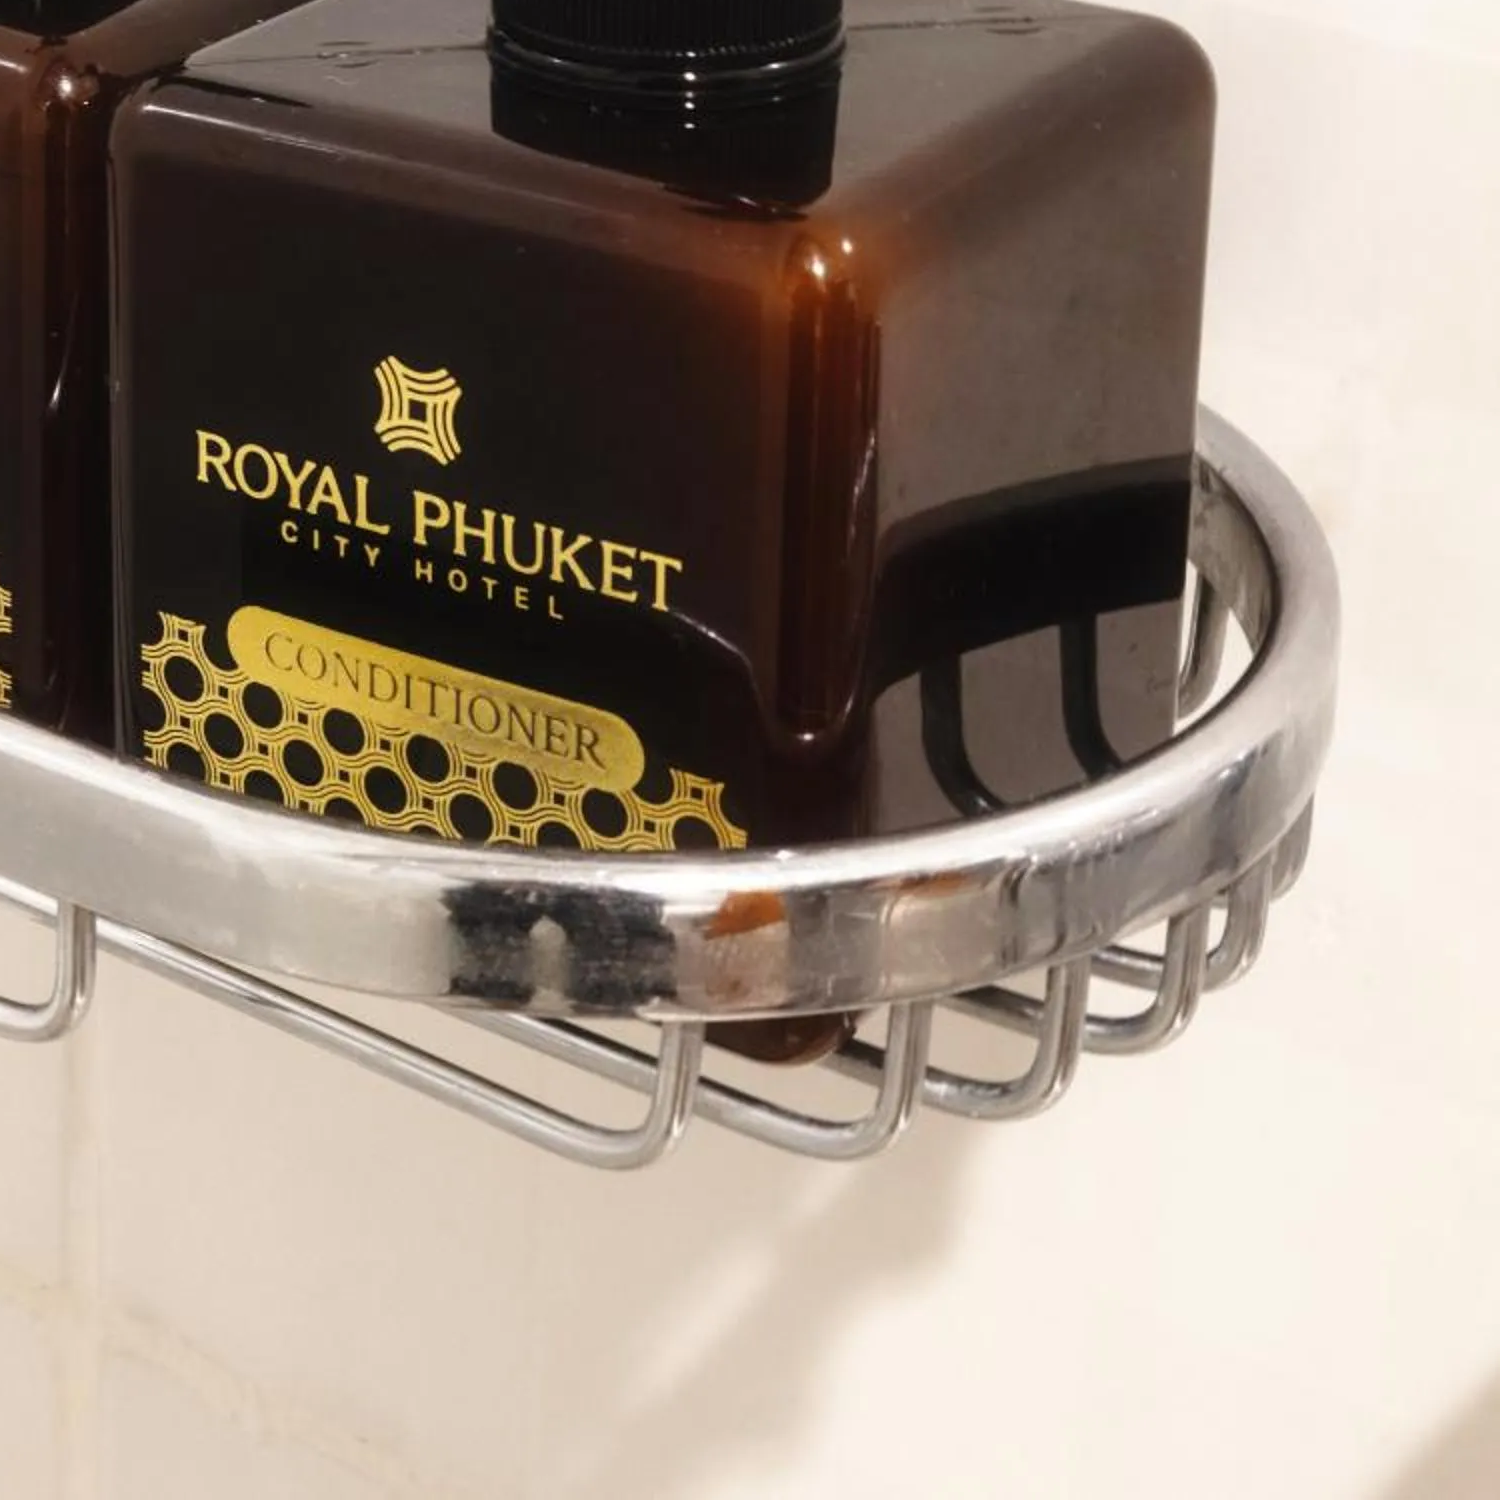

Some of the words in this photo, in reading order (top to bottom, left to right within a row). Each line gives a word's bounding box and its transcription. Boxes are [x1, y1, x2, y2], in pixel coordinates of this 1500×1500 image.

[196, 429, 390, 536] ROYAL
[413, 491, 682, 611] PHUKET
[281, 521, 380, 567] CITY
[415, 562, 564, 620] HOTEL
[265, 631, 606, 770] CONDITIONER
